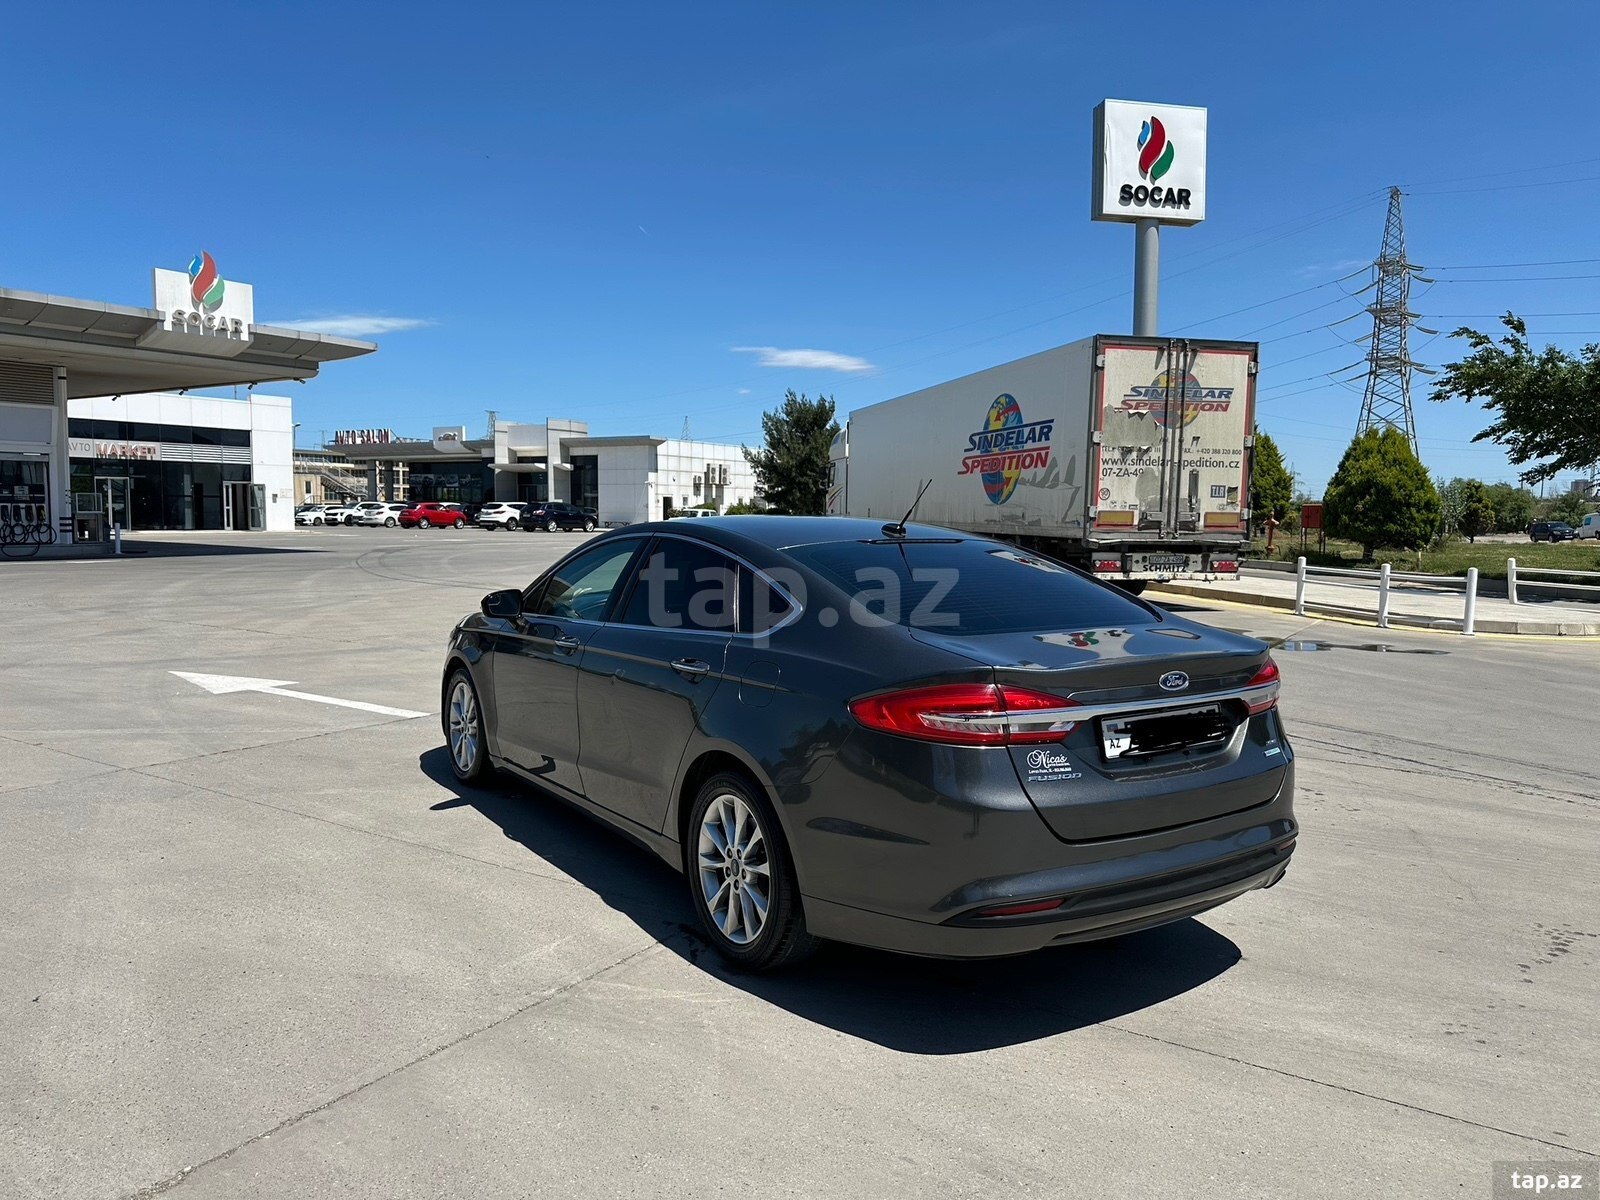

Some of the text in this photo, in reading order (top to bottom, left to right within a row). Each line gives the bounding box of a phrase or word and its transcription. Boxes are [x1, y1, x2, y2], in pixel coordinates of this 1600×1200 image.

[1120, 184, 1191, 206] SOCAR
[172, 309, 243, 333] SOCAR
[360, 428, 389, 443] SALON
[964, 419, 1054, 452] SINDELAR
[96, 443, 156, 457] MARKET
[958, 446, 1050, 475] SPEDITION
[1166, 674, 1184, 687] Ford
[1110, 738, 1121, 749] AZ
[1028, 773, 1082, 781] FUSION
